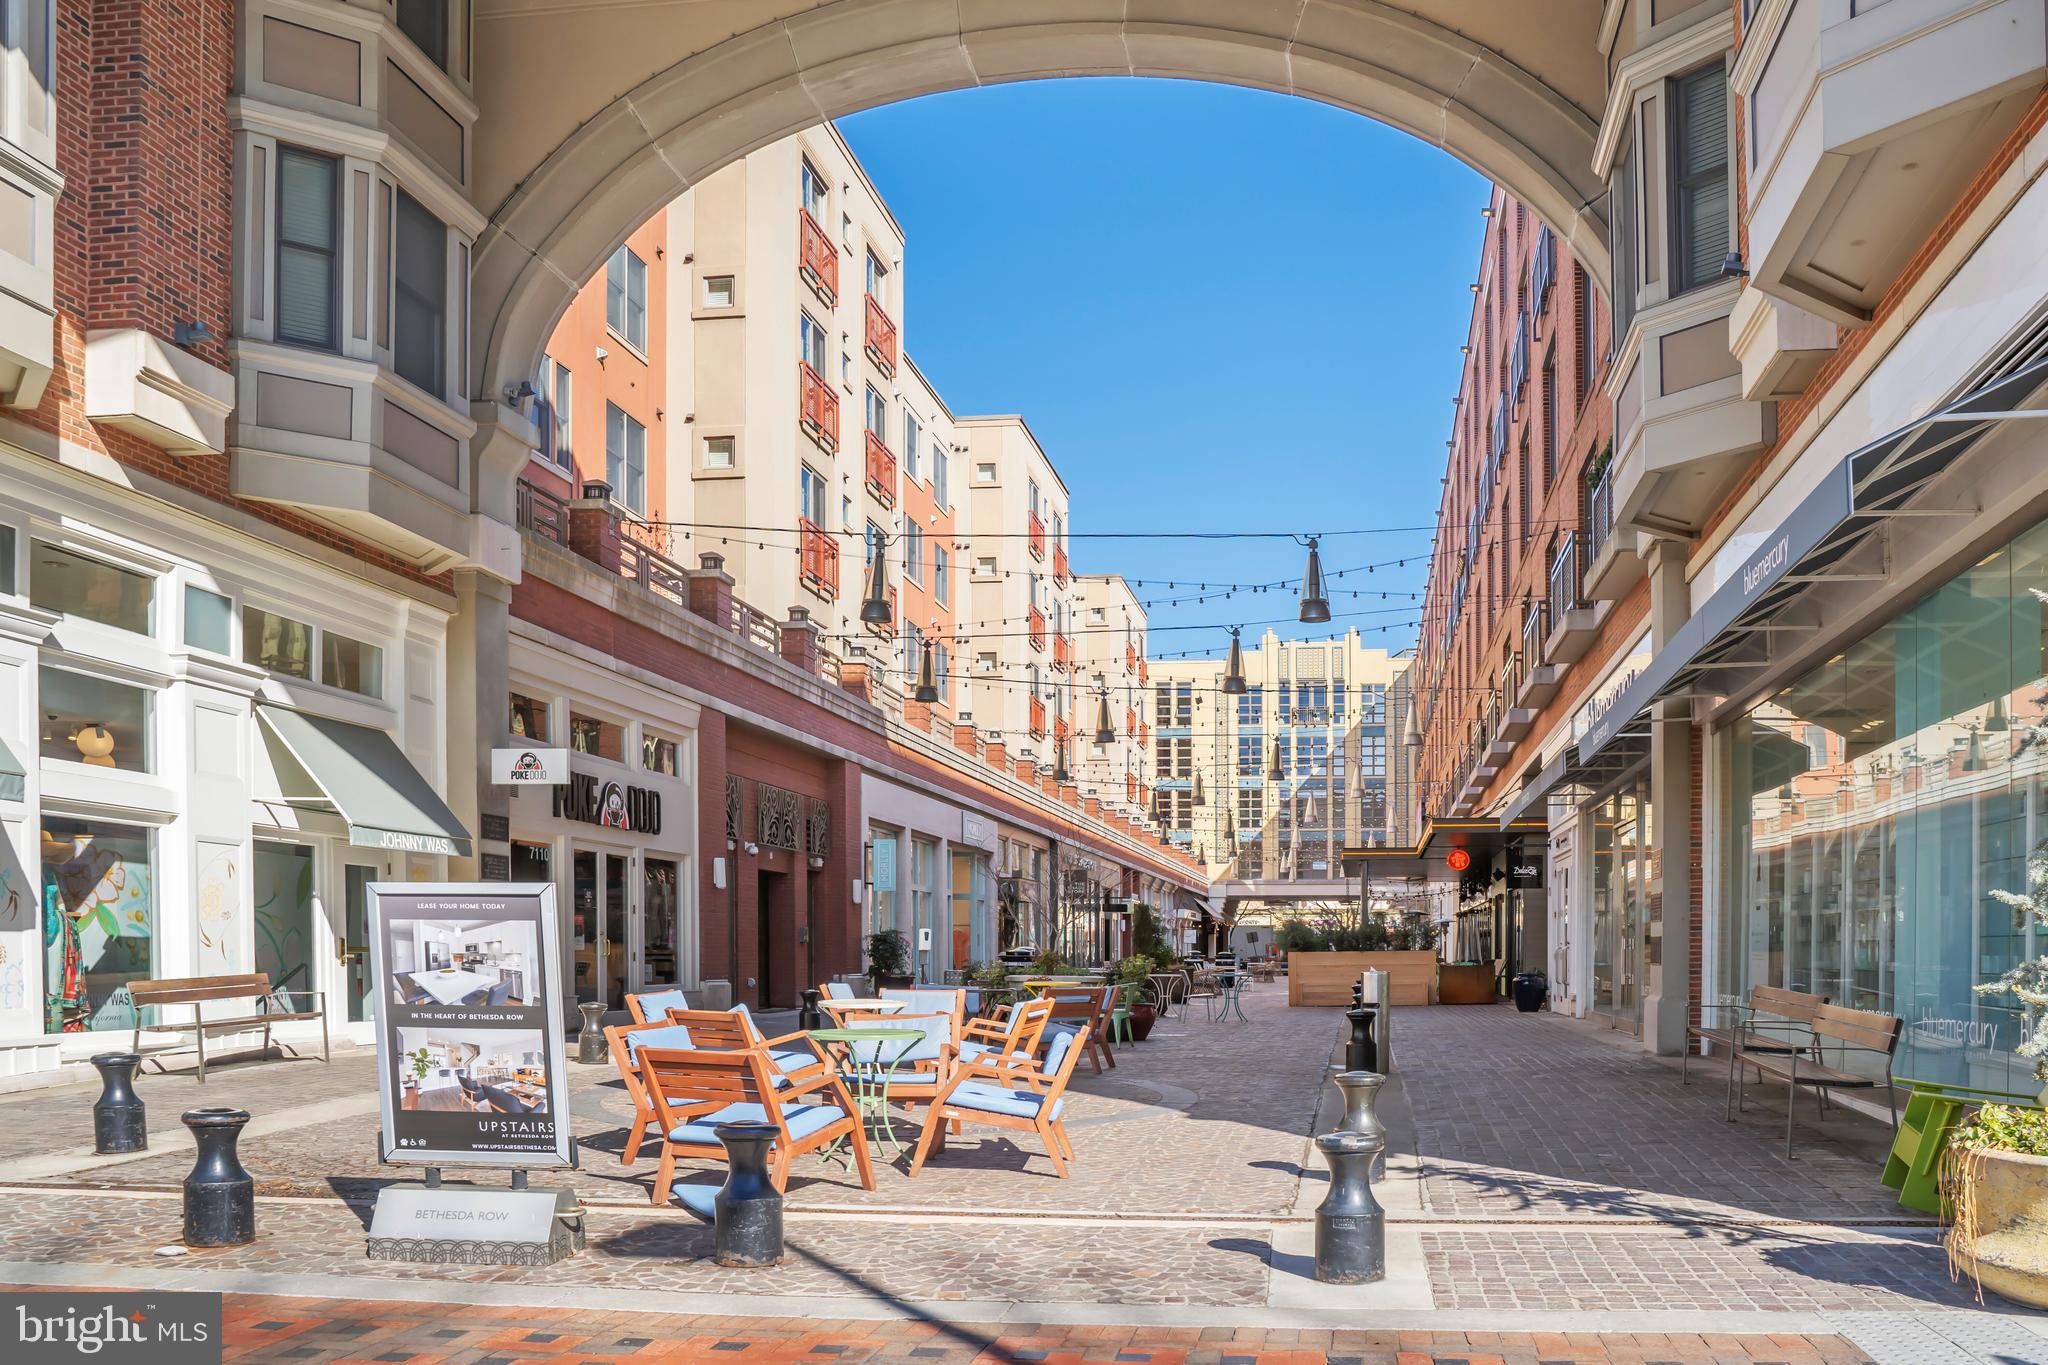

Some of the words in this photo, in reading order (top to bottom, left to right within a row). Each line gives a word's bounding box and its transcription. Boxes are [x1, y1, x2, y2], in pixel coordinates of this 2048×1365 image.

[1743, 534, 1789, 596] bluemercury
[511, 771, 529, 780] POKE
[553, 771, 600, 826] POKE
[627, 785, 661, 835] DOJO
[380, 832, 424, 851] JOHNNY
[424, 838, 449, 853] WAS
[529, 846, 550, 862] 7110
[110, 993, 130, 1006] WAS
[1922, 1007, 1998, 1055] bluemercury
[479, 1120, 554, 1133] UPSTAIRS
[415, 1209, 474, 1221] BETHESDA
[478, 1211, 509, 1221] ROW
